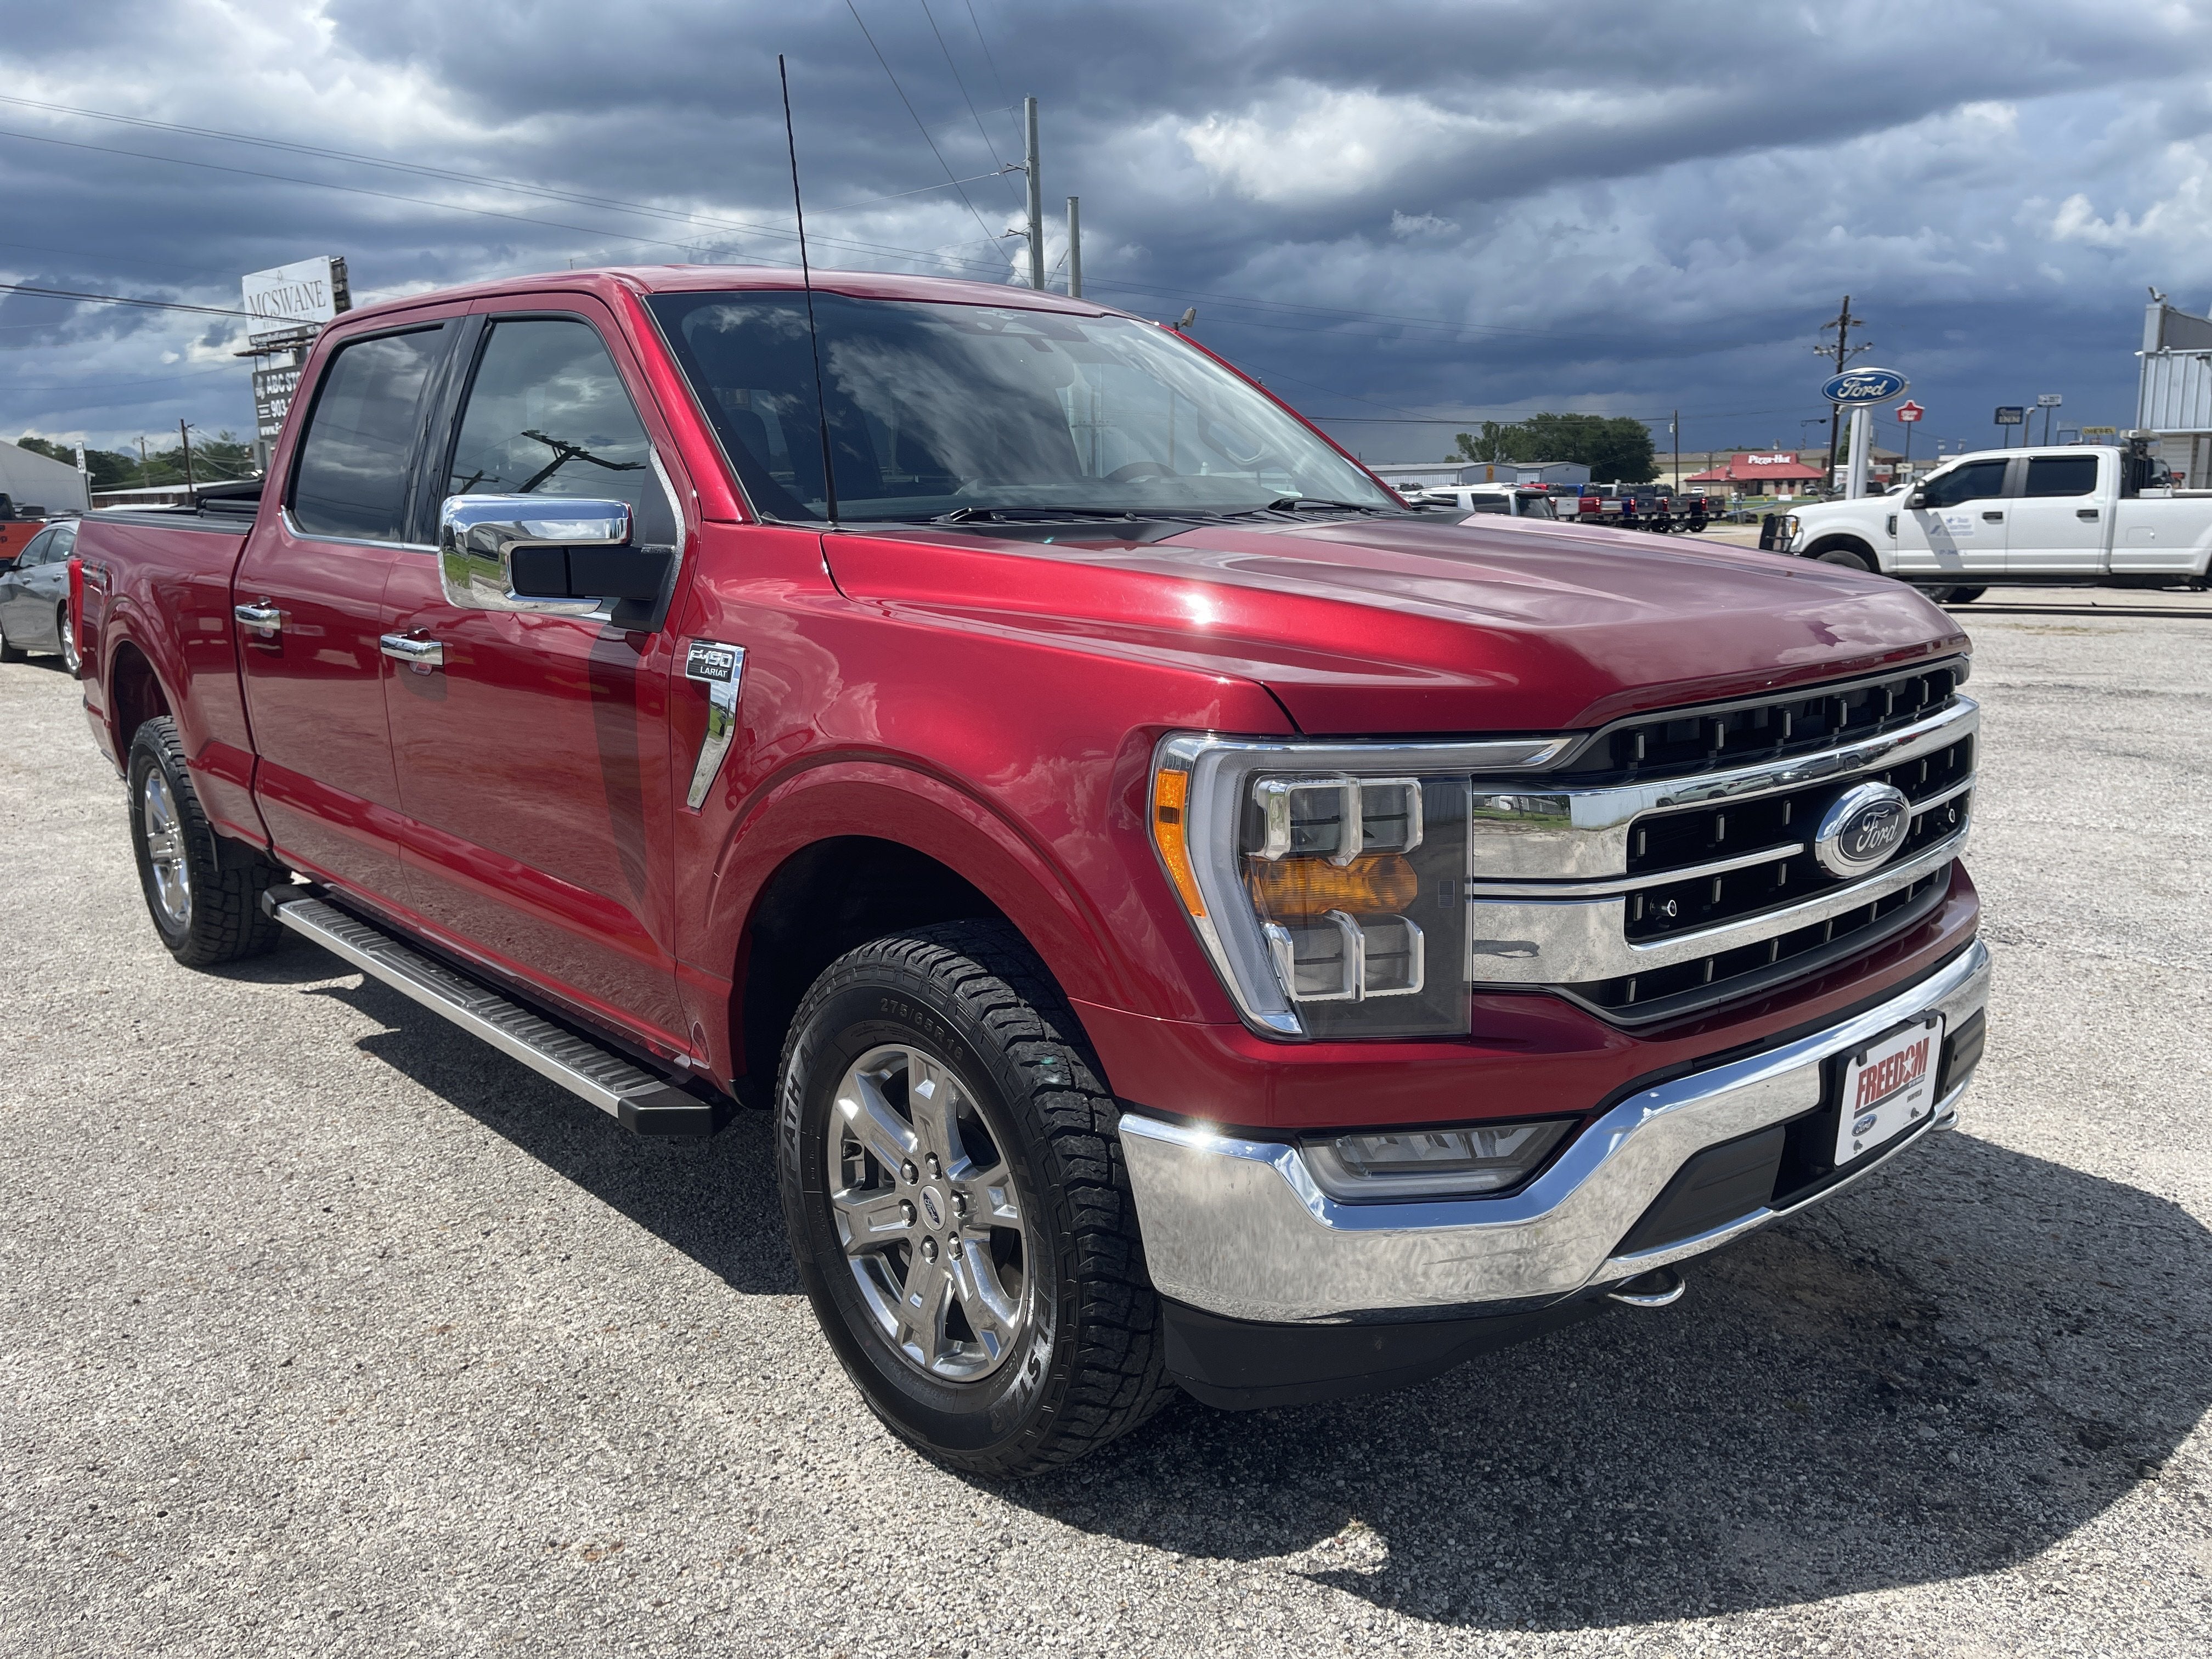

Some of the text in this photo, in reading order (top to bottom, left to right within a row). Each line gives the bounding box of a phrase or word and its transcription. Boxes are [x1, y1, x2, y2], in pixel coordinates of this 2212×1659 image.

[249, 280, 326, 321] MCSWANE
[267, 373, 285, 394] ABC
[1837, 376, 1889, 398] Ford
[689, 650, 733, 668] F-150
[700, 666, 728, 678] LARIAT
[1856, 809, 1899, 853] Ford
[1855, 1036, 1930, 1110] FREEDOM
[1856, 1117, 1874, 1134] Ford
[924, 1199, 938, 1220] Ford
